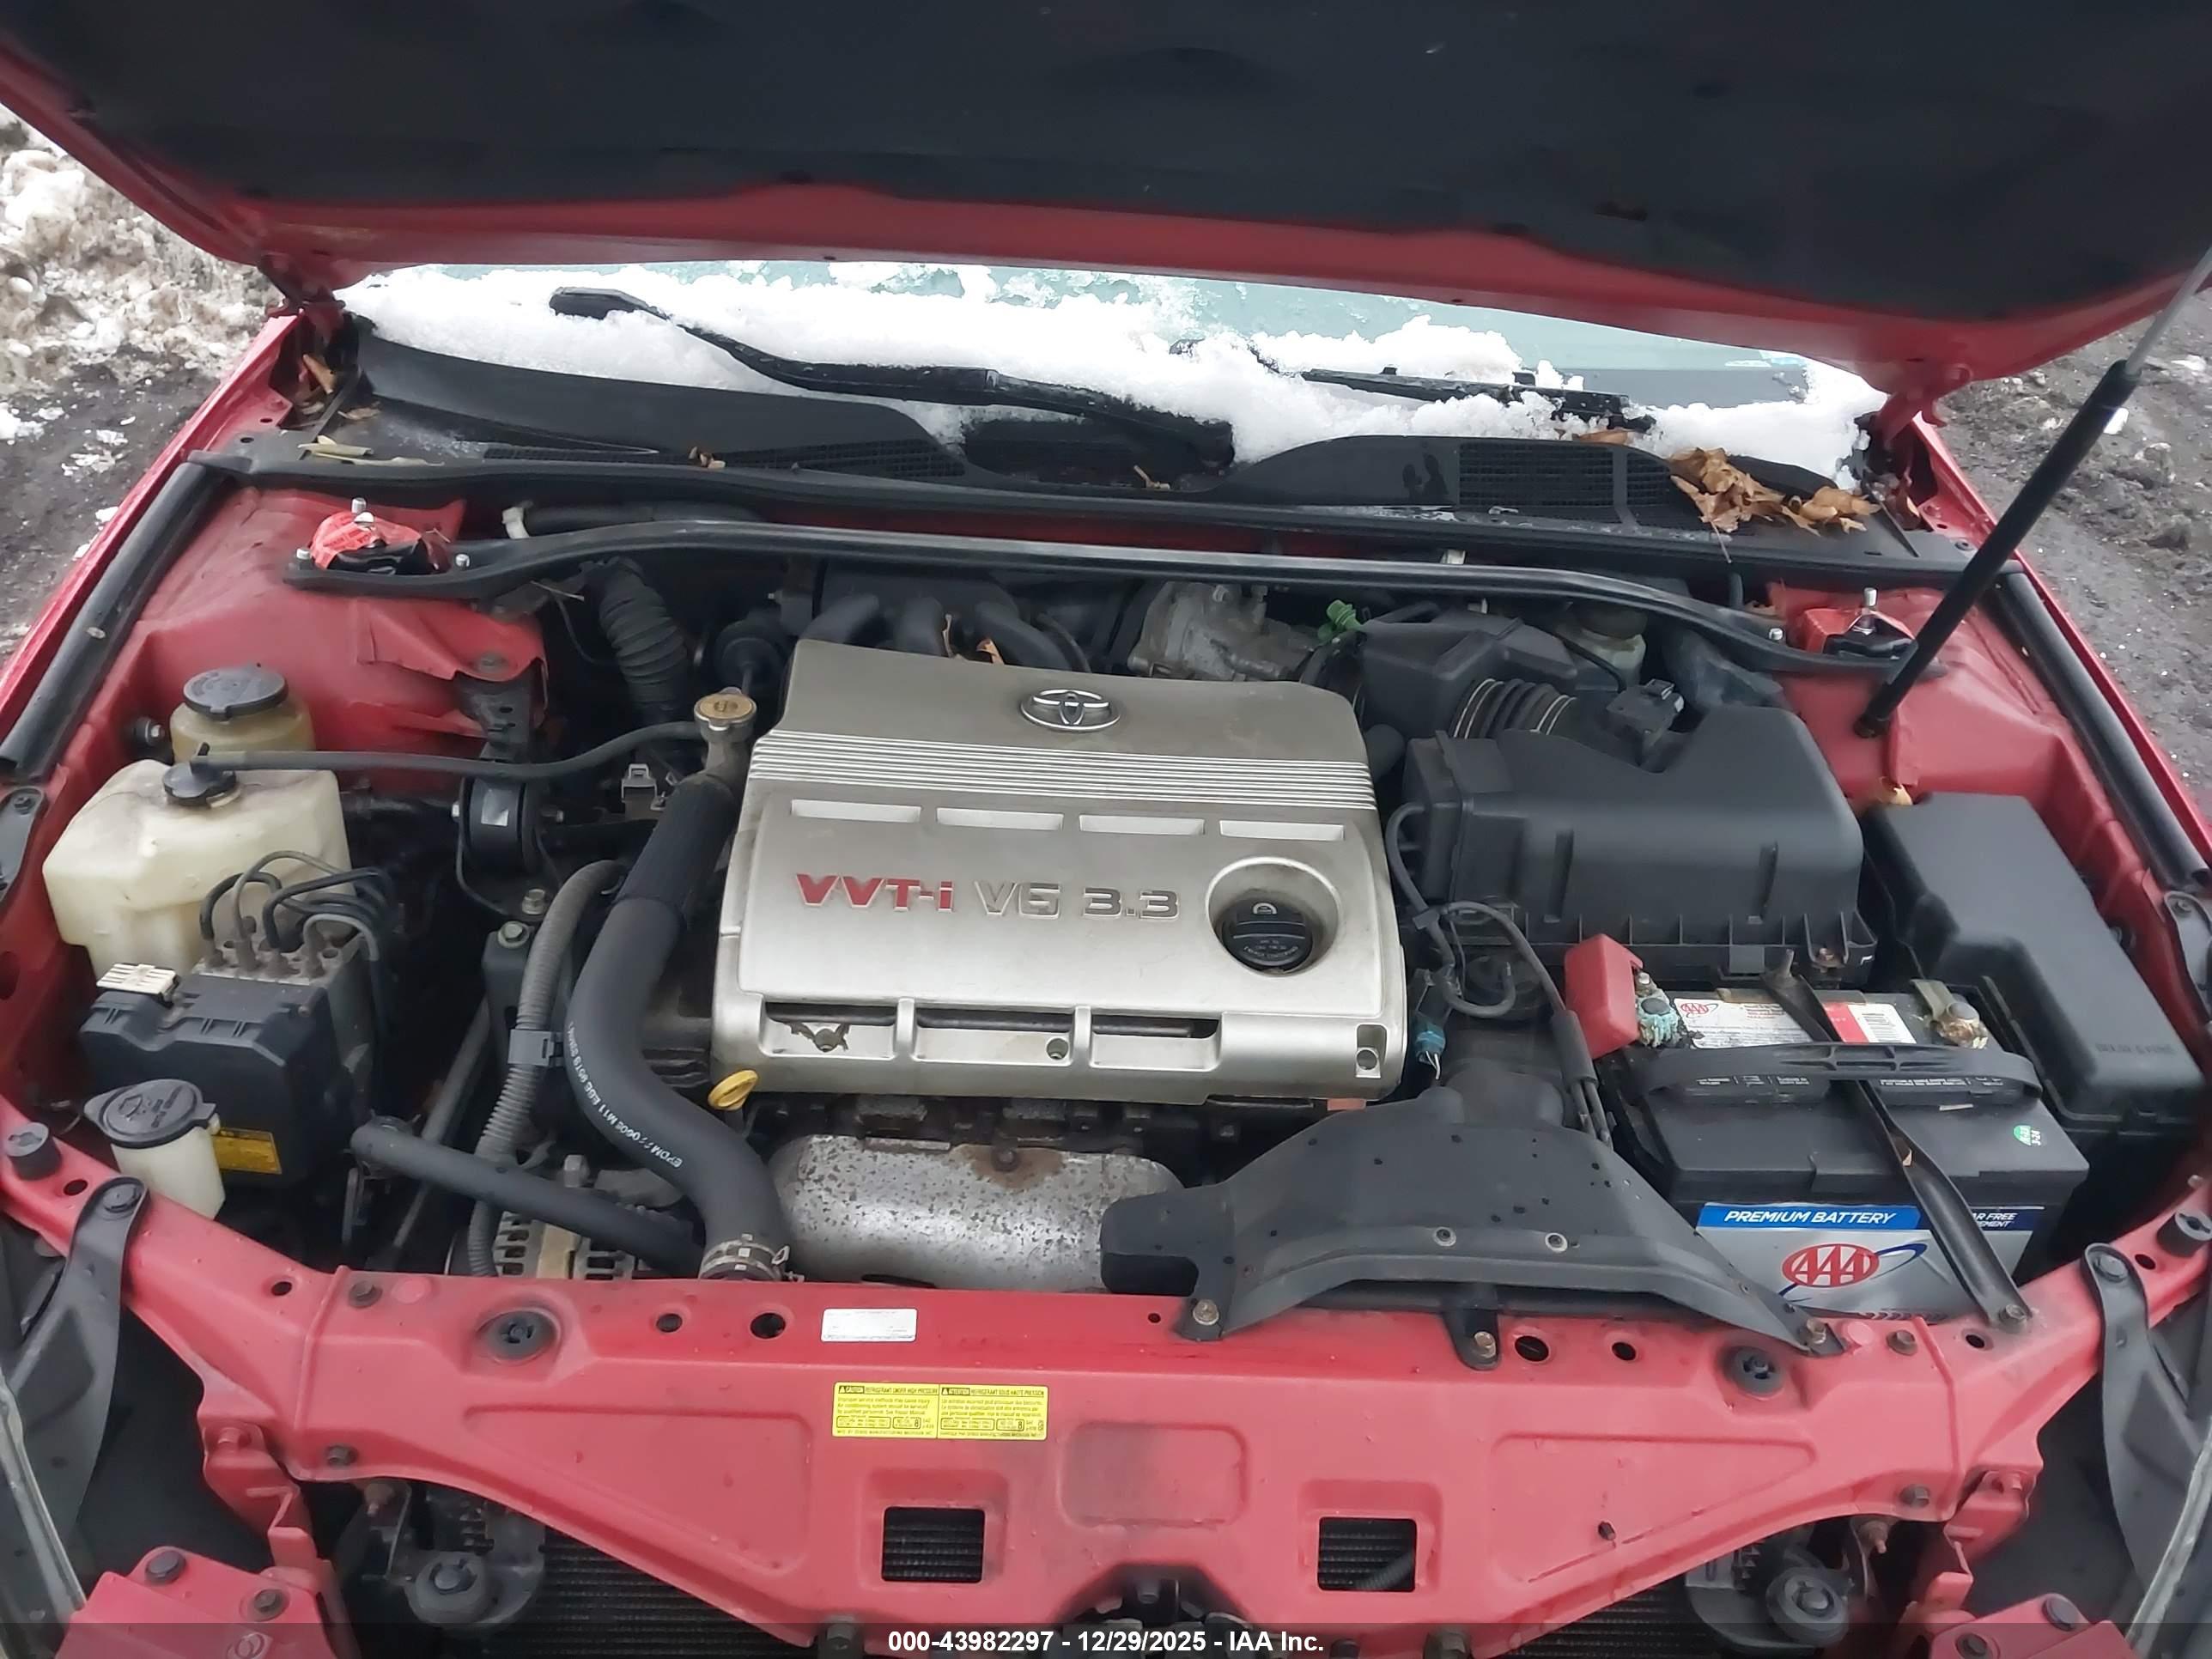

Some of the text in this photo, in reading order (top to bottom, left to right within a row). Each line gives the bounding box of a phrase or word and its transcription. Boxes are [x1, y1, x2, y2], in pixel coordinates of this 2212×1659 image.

[796, 872, 1182, 921] VVT-i V6 3.3
[1724, 1210, 1897, 1224] PREMIUM BATTERY
[1985, 1212, 2019, 1221] FREE
[1787, 1243, 1875, 1287] AAA
